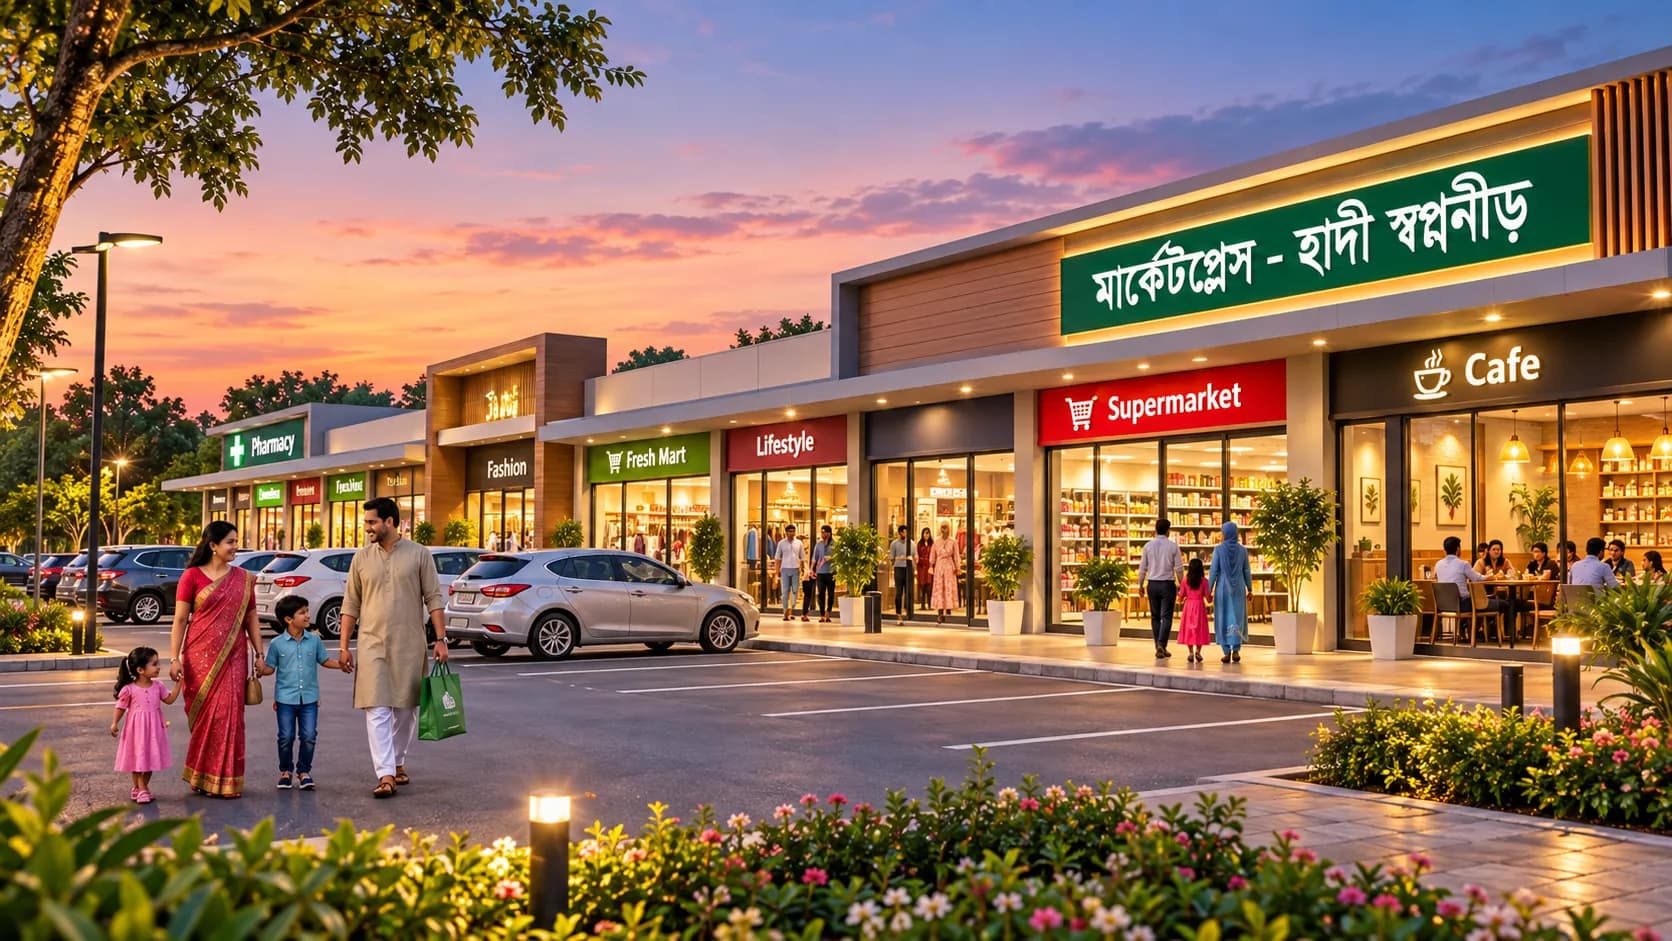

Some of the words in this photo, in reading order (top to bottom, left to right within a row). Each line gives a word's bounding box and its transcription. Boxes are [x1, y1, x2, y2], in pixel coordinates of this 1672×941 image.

[1092, 240, 1257, 310] মার্কেটপ্লেস
[1266, 254, 1284, 265] -
[1294, 198, 1376, 277] হাদী
[1385, 171, 1534, 254] স্বপ্ননীড়
[1465, 346, 1541, 386] Cafe
[1108, 382, 1242, 424] Supermarket
[251, 434, 296, 457] Pharmacy
[626, 447, 656, 469] Fresh
[658, 446, 687, 466] Mart
[756, 430, 815, 459] Lifestyle
[487, 457, 527, 479] Fashion
